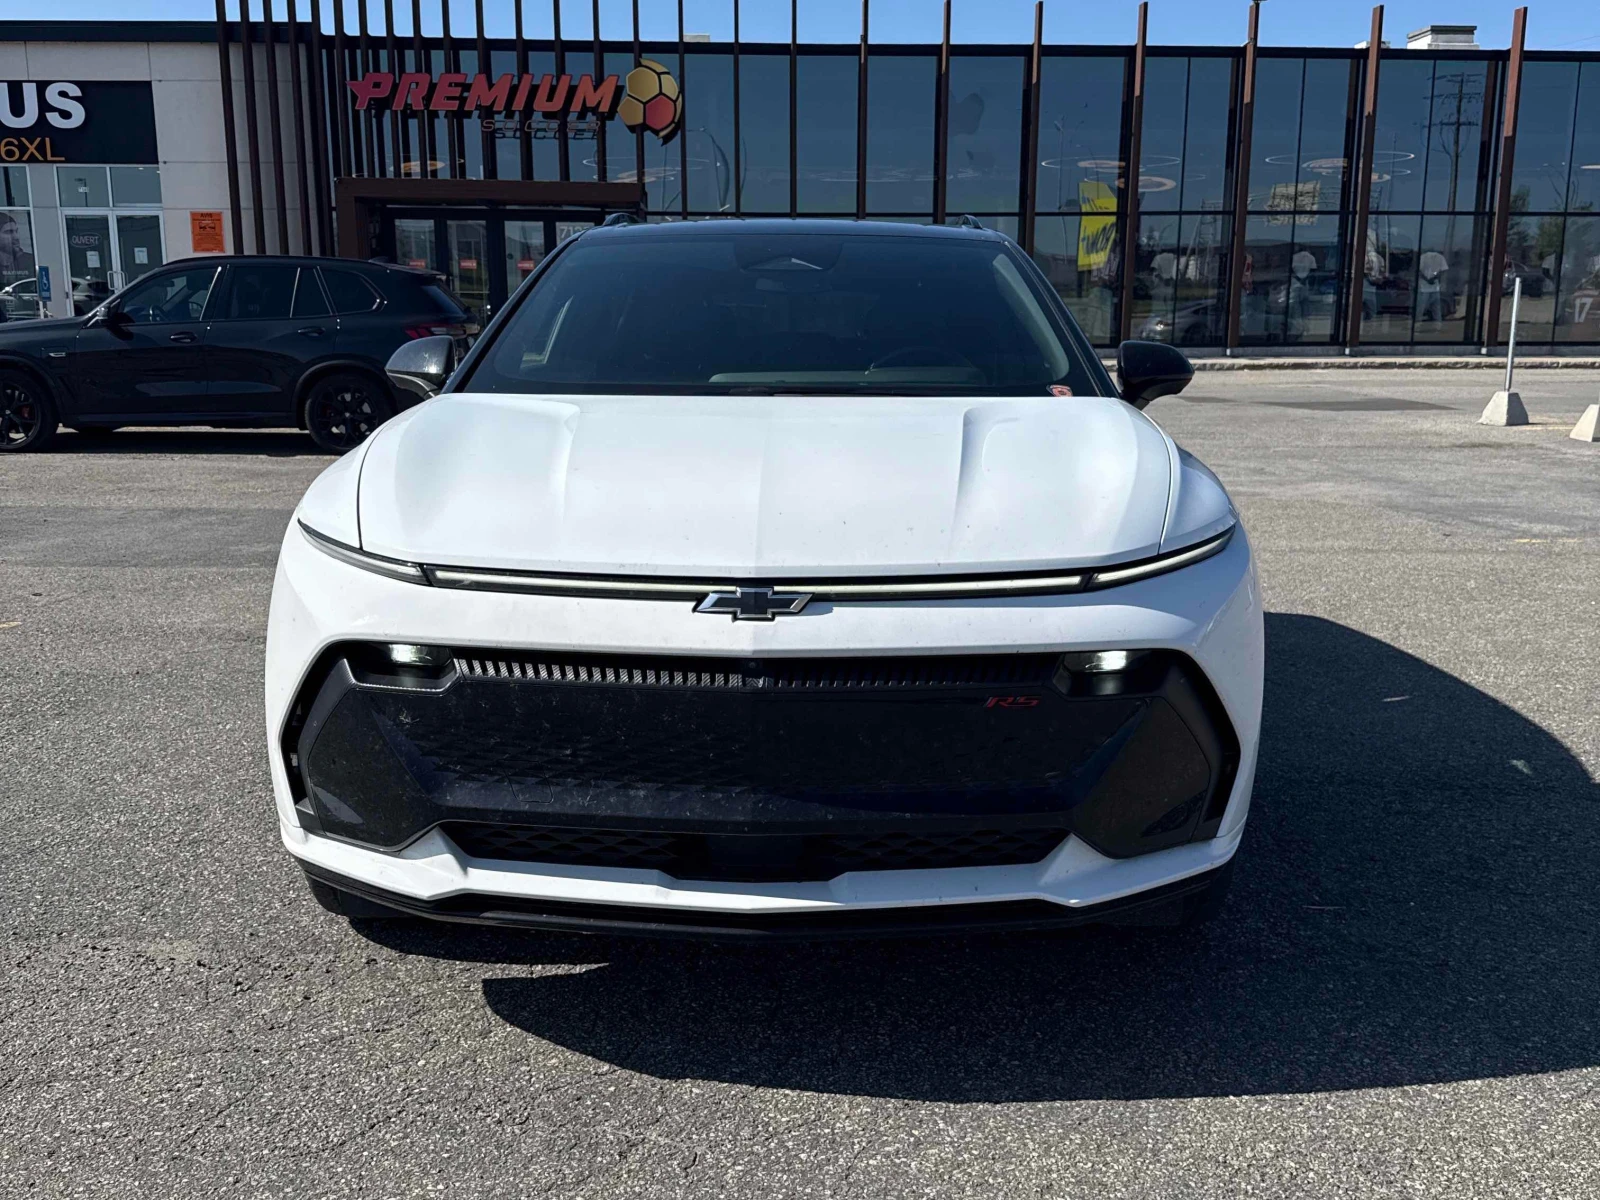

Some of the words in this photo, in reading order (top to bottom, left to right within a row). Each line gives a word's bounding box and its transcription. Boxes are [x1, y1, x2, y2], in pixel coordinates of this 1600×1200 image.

[346, 72, 620, 113] PREMIUM
[0, 82, 86, 129] US
[482, 119, 600, 132] SOCCER
[0, 137, 66, 161] 6XL
[72, 235, 99, 245] OUVERT
[1574, 297, 1594, 323] 17
[983, 697, 1041, 708] RS
